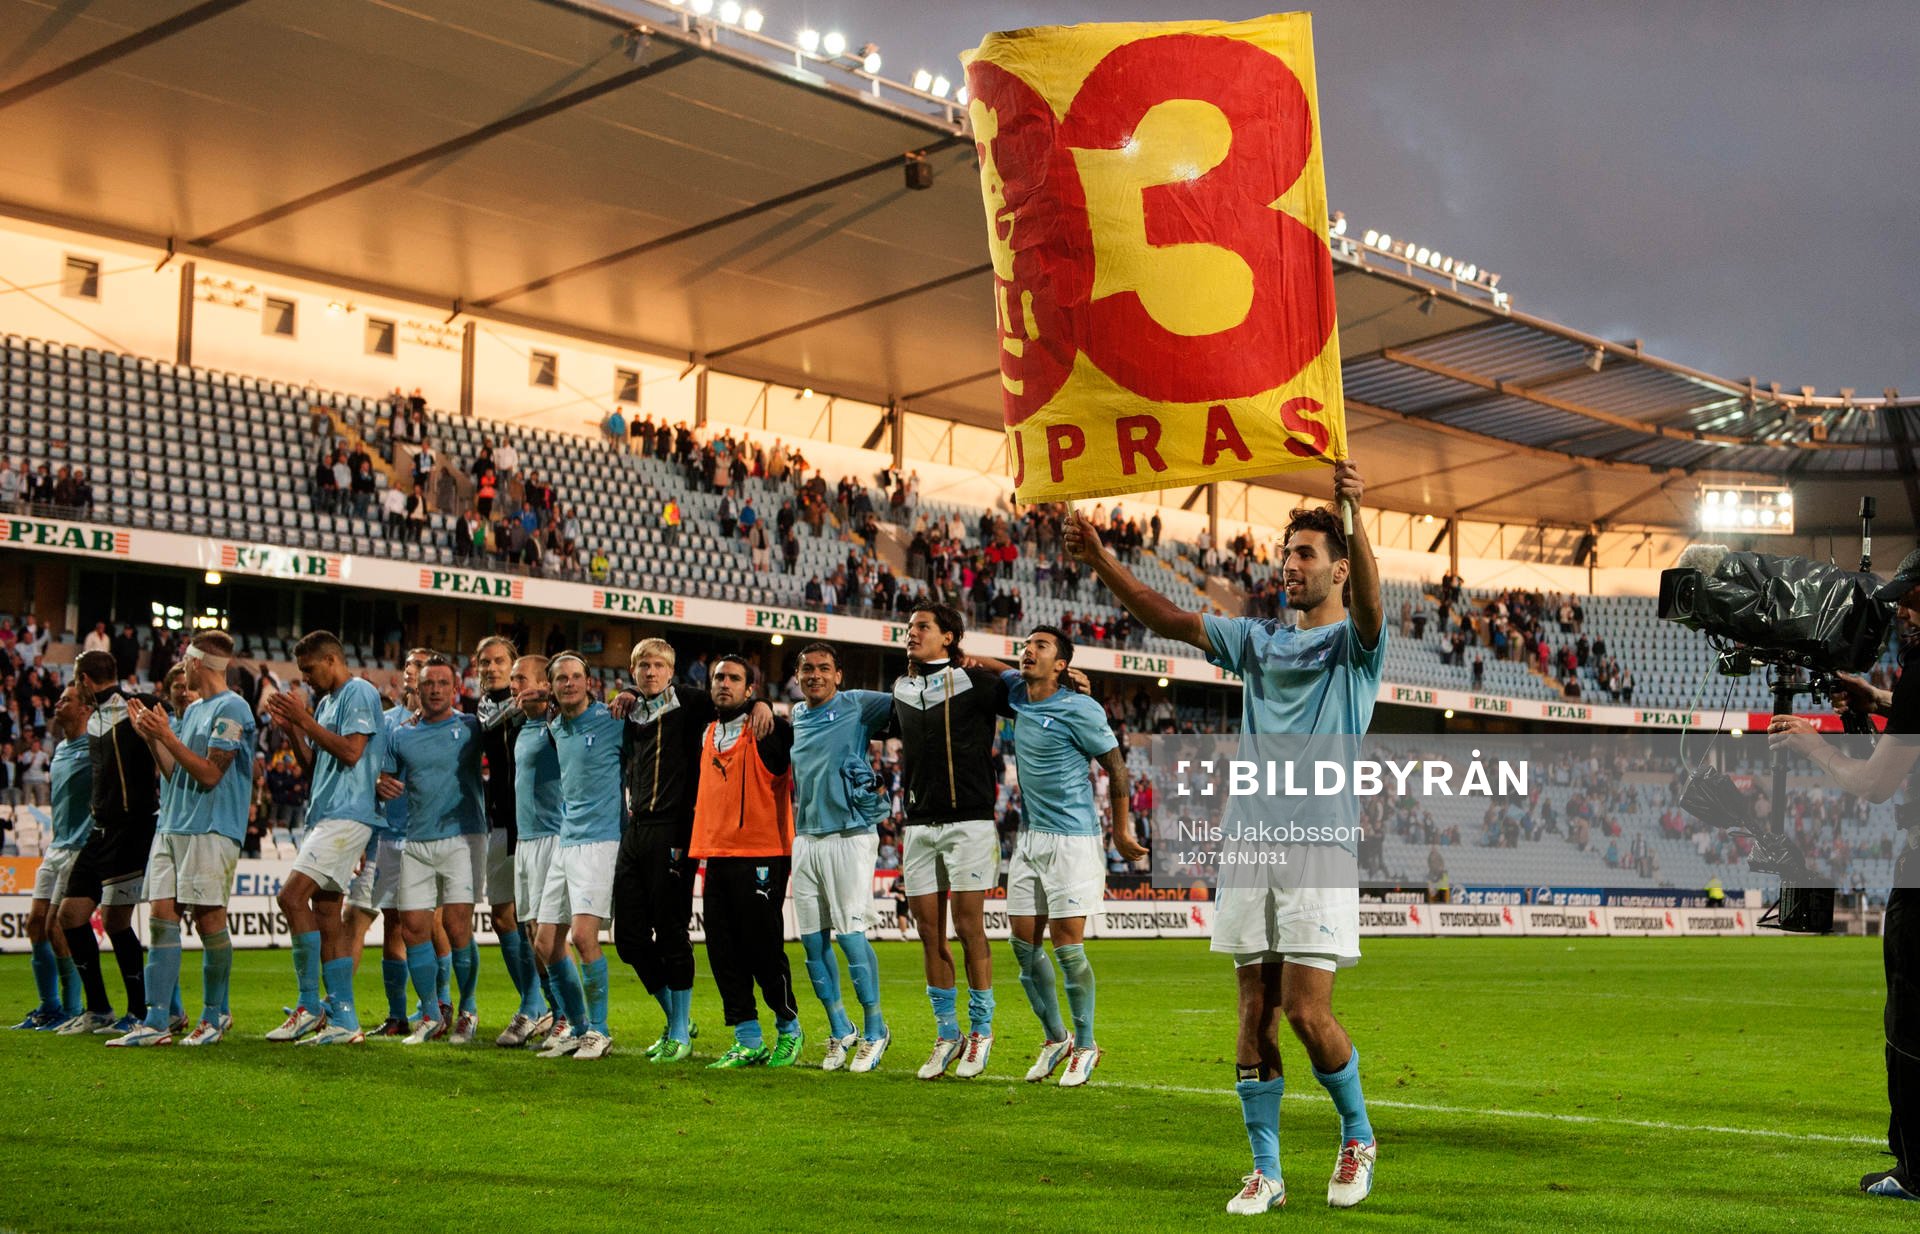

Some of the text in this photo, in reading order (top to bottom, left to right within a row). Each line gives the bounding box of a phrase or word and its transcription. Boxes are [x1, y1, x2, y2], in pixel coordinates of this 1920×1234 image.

[8, 520, 116, 552] PEAB
[432, 571, 512, 598] PEAB
[603, 592, 674, 617] PEAB
[755, 610, 818, 633] PEAB
[1121, 656, 1167, 673] PEAB
[1396, 687, 1433, 704] PEAB
[1474, 697, 1507, 712] PEAB
[1548, 705, 1587, 720] PEAB
[1642, 712, 1693, 725] PEAB
[1106, 912, 1188, 929] SYDSVENSKAN
